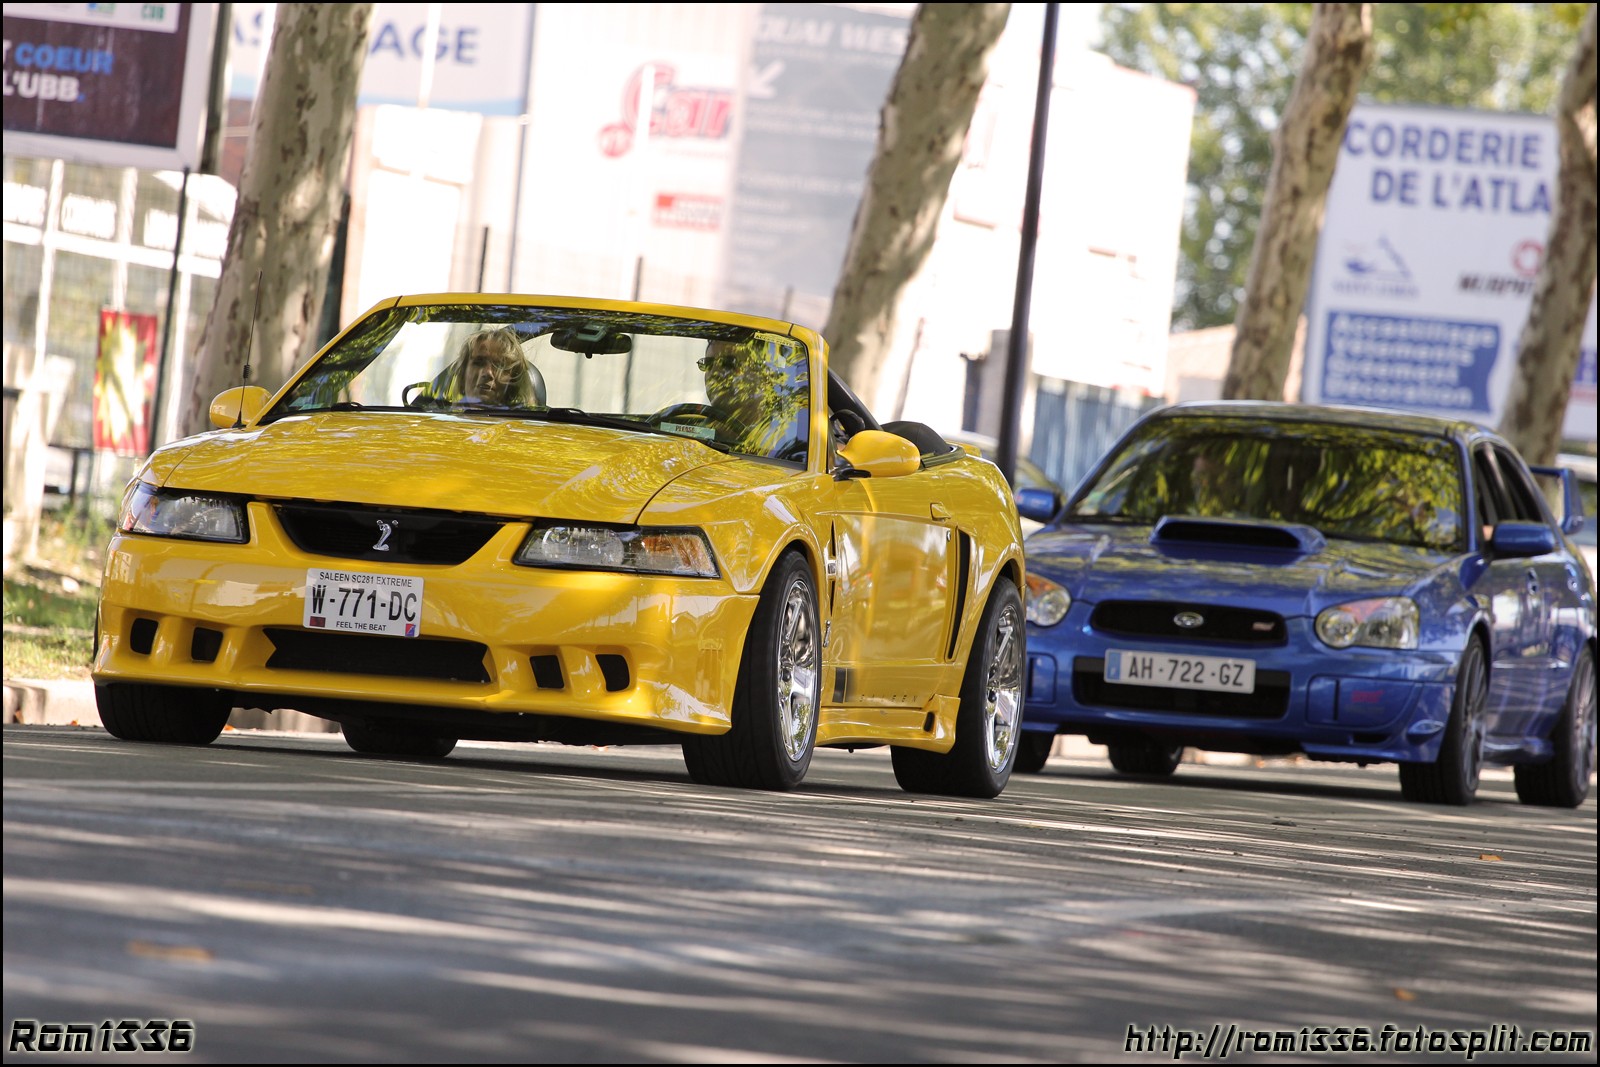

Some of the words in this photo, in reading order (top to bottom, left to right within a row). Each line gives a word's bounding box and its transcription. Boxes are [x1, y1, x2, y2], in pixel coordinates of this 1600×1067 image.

[14, 42, 114, 75] COEUR
[1344, 120, 1541, 170] CORDERIE
[1371, 168, 1420, 207] DE
[319, 571, 350, 582] SALEEN
[351, 574, 374, 585] SC281
[376, 576, 413, 588] EXTREME
[312, 584, 417, 622] W-771-DC
[335, 620, 353, 629] FEEL
[354, 622, 367, 631] THE
[369, 623, 387, 632] BEAT
[1128, 656, 1244, 687] AH-722-GZ
